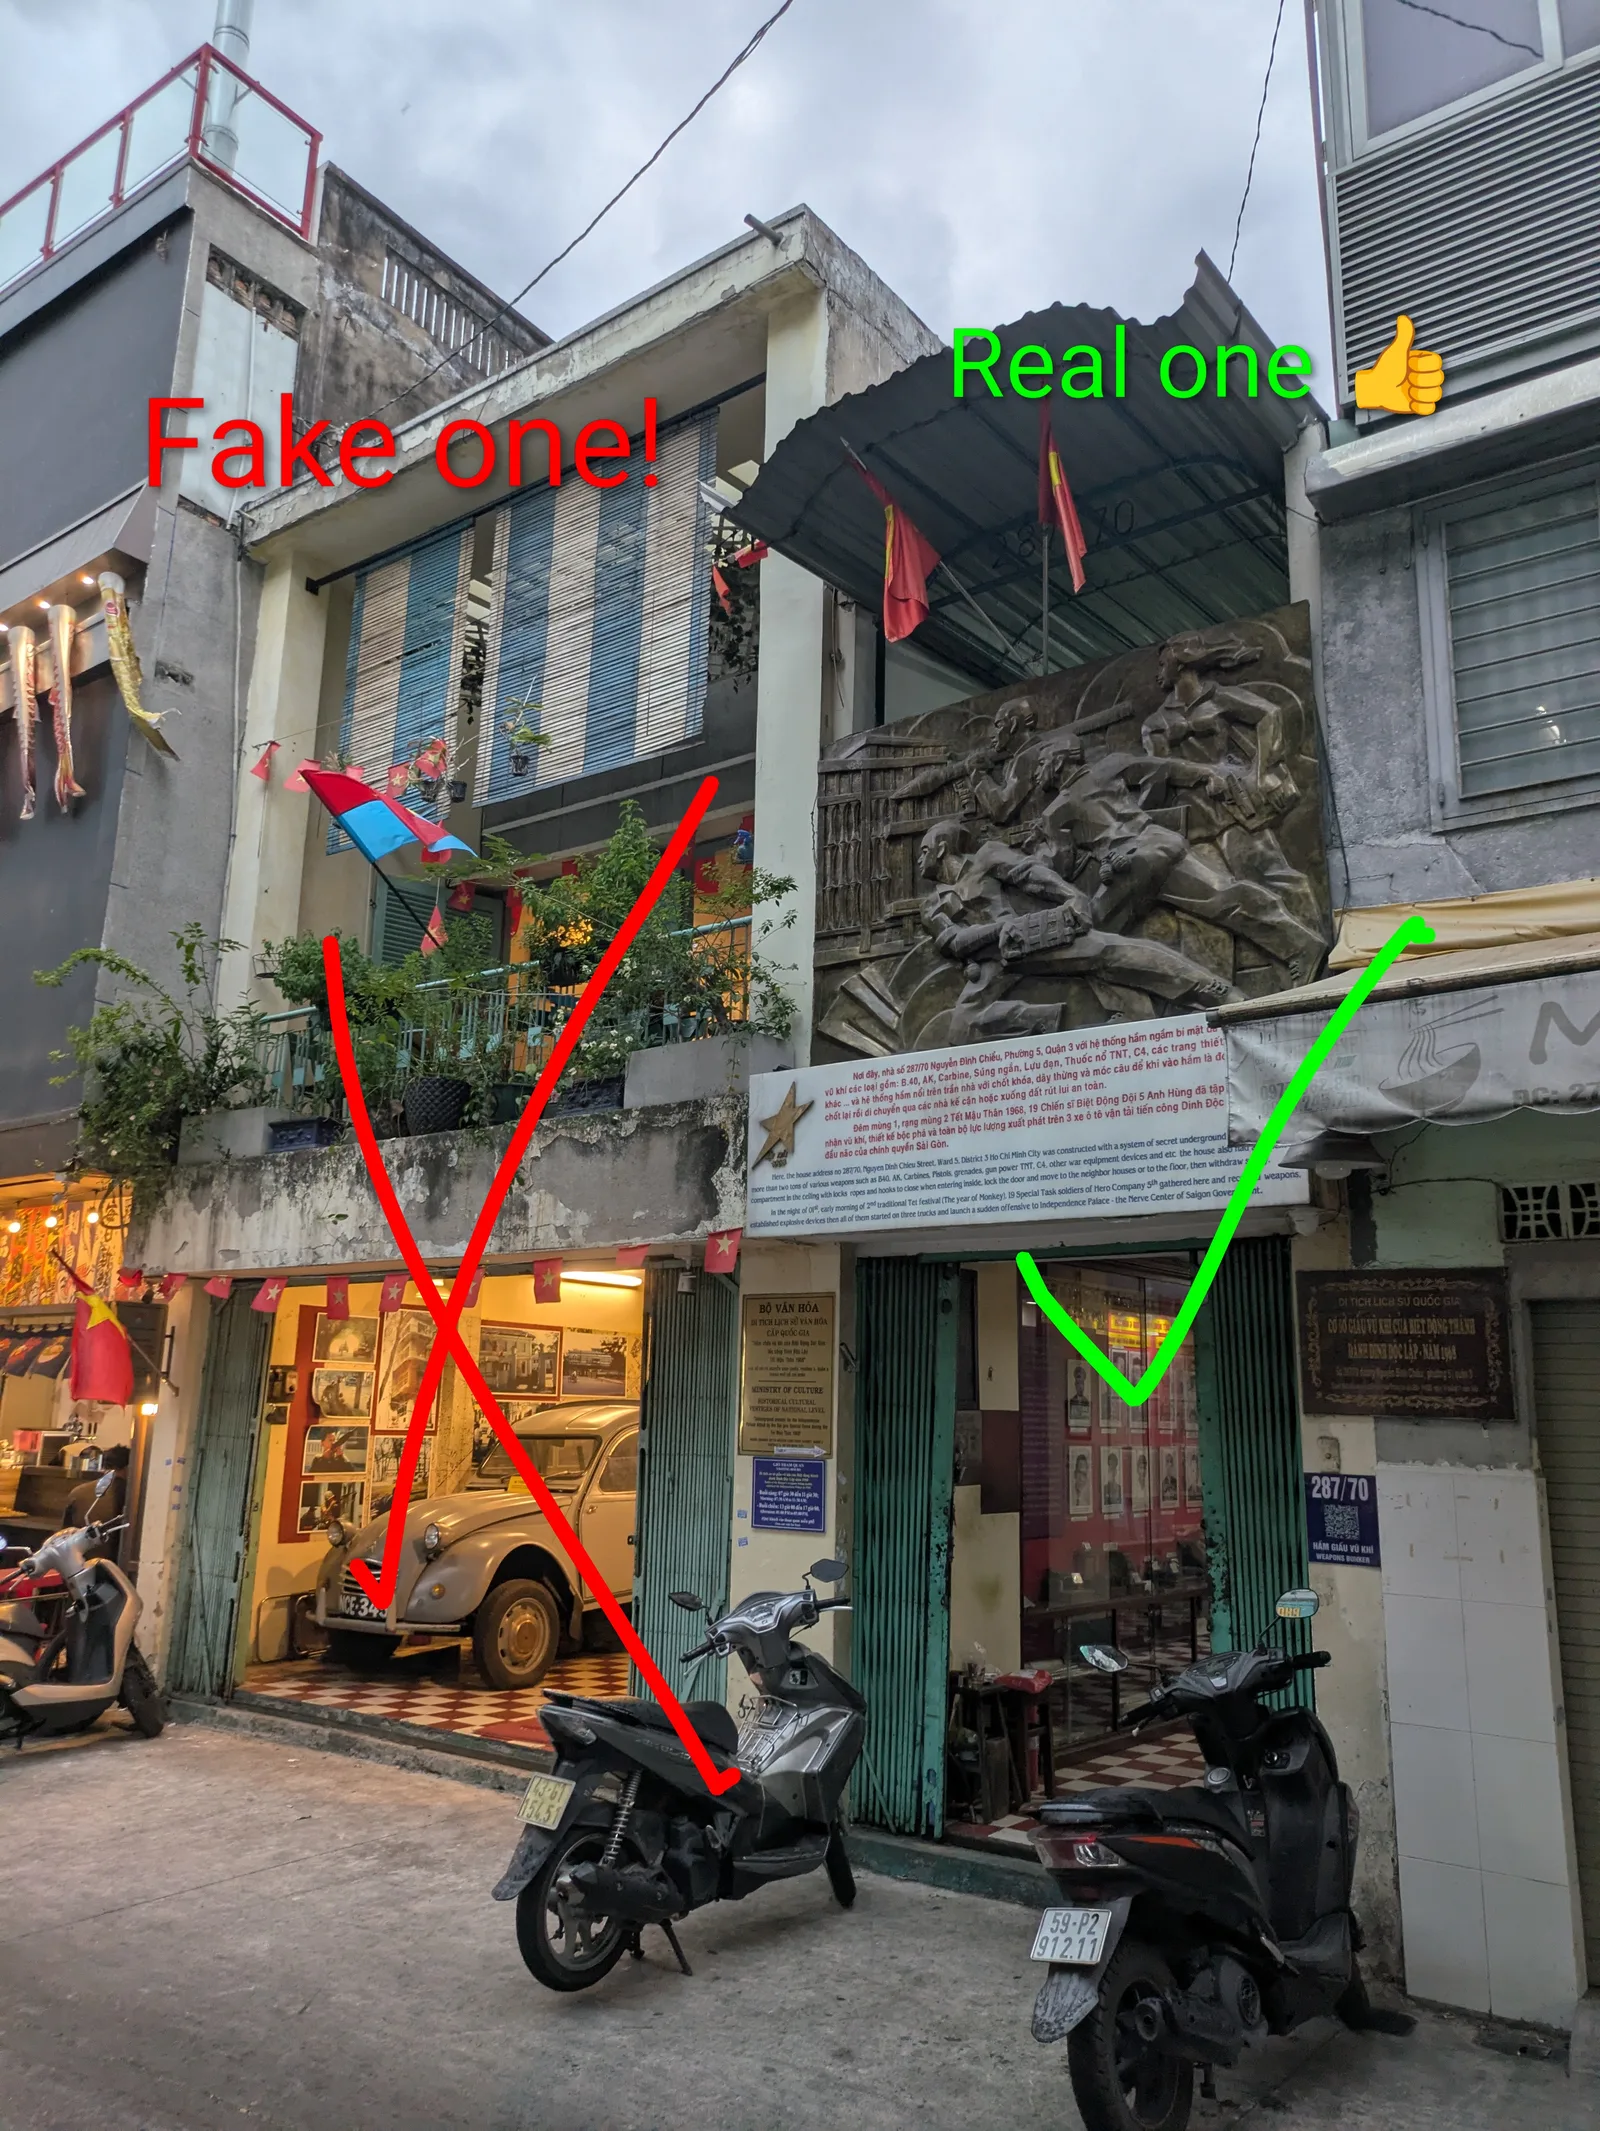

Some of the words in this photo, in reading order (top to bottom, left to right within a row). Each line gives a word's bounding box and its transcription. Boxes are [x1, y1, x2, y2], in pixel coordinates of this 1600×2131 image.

[906, 1062, 928, 1073] 287/70
[1068, 1042, 1073, 1051] 3
[1170, 1042, 1196, 1051] trang
[943, 1114, 948, 1122] 2
[1028, 1103, 1038, 1112] 19
[1139, 1091, 1144, 1100] 5
[1146, 1089, 1165, 1100] Anh
[759, 1302, 772, 1315] BỘ
[793, 1386, 824, 1394] CULTURE
[1311, 1475, 1369, 1501] 287/70
[1316, 1553, 1345, 1562] WEAPONS
[1050, 1912, 1100, 1935] 59-P2
[1036, 1935, 1098, 1961] 912.11
